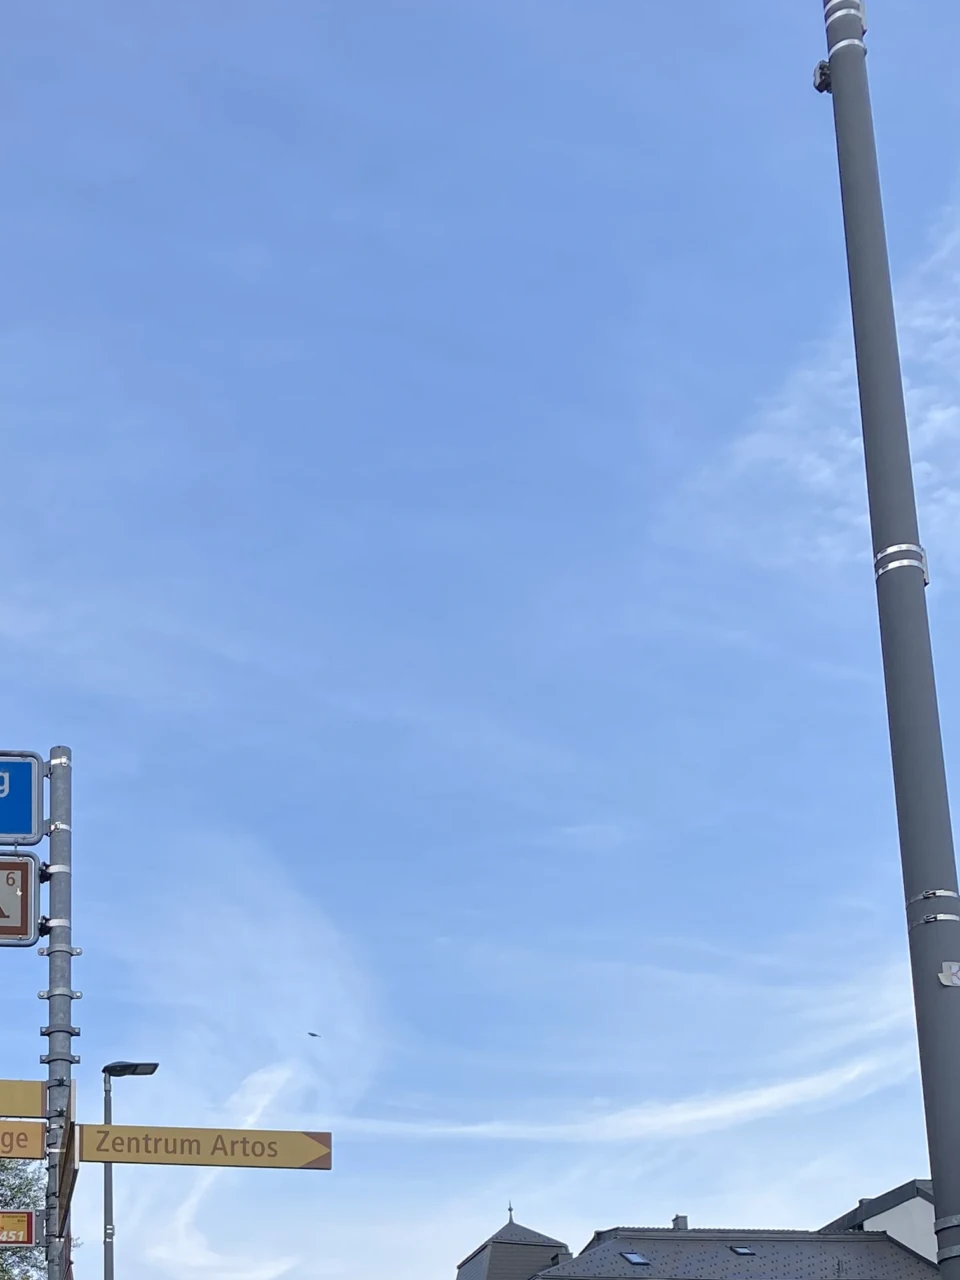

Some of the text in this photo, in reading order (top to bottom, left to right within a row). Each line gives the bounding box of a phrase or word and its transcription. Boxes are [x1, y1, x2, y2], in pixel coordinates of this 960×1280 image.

[5, 872, 17, 887] 6
[96, 1130, 279, 1158] Zentrum Artos
[0, 1231, 24, 1241] 451
